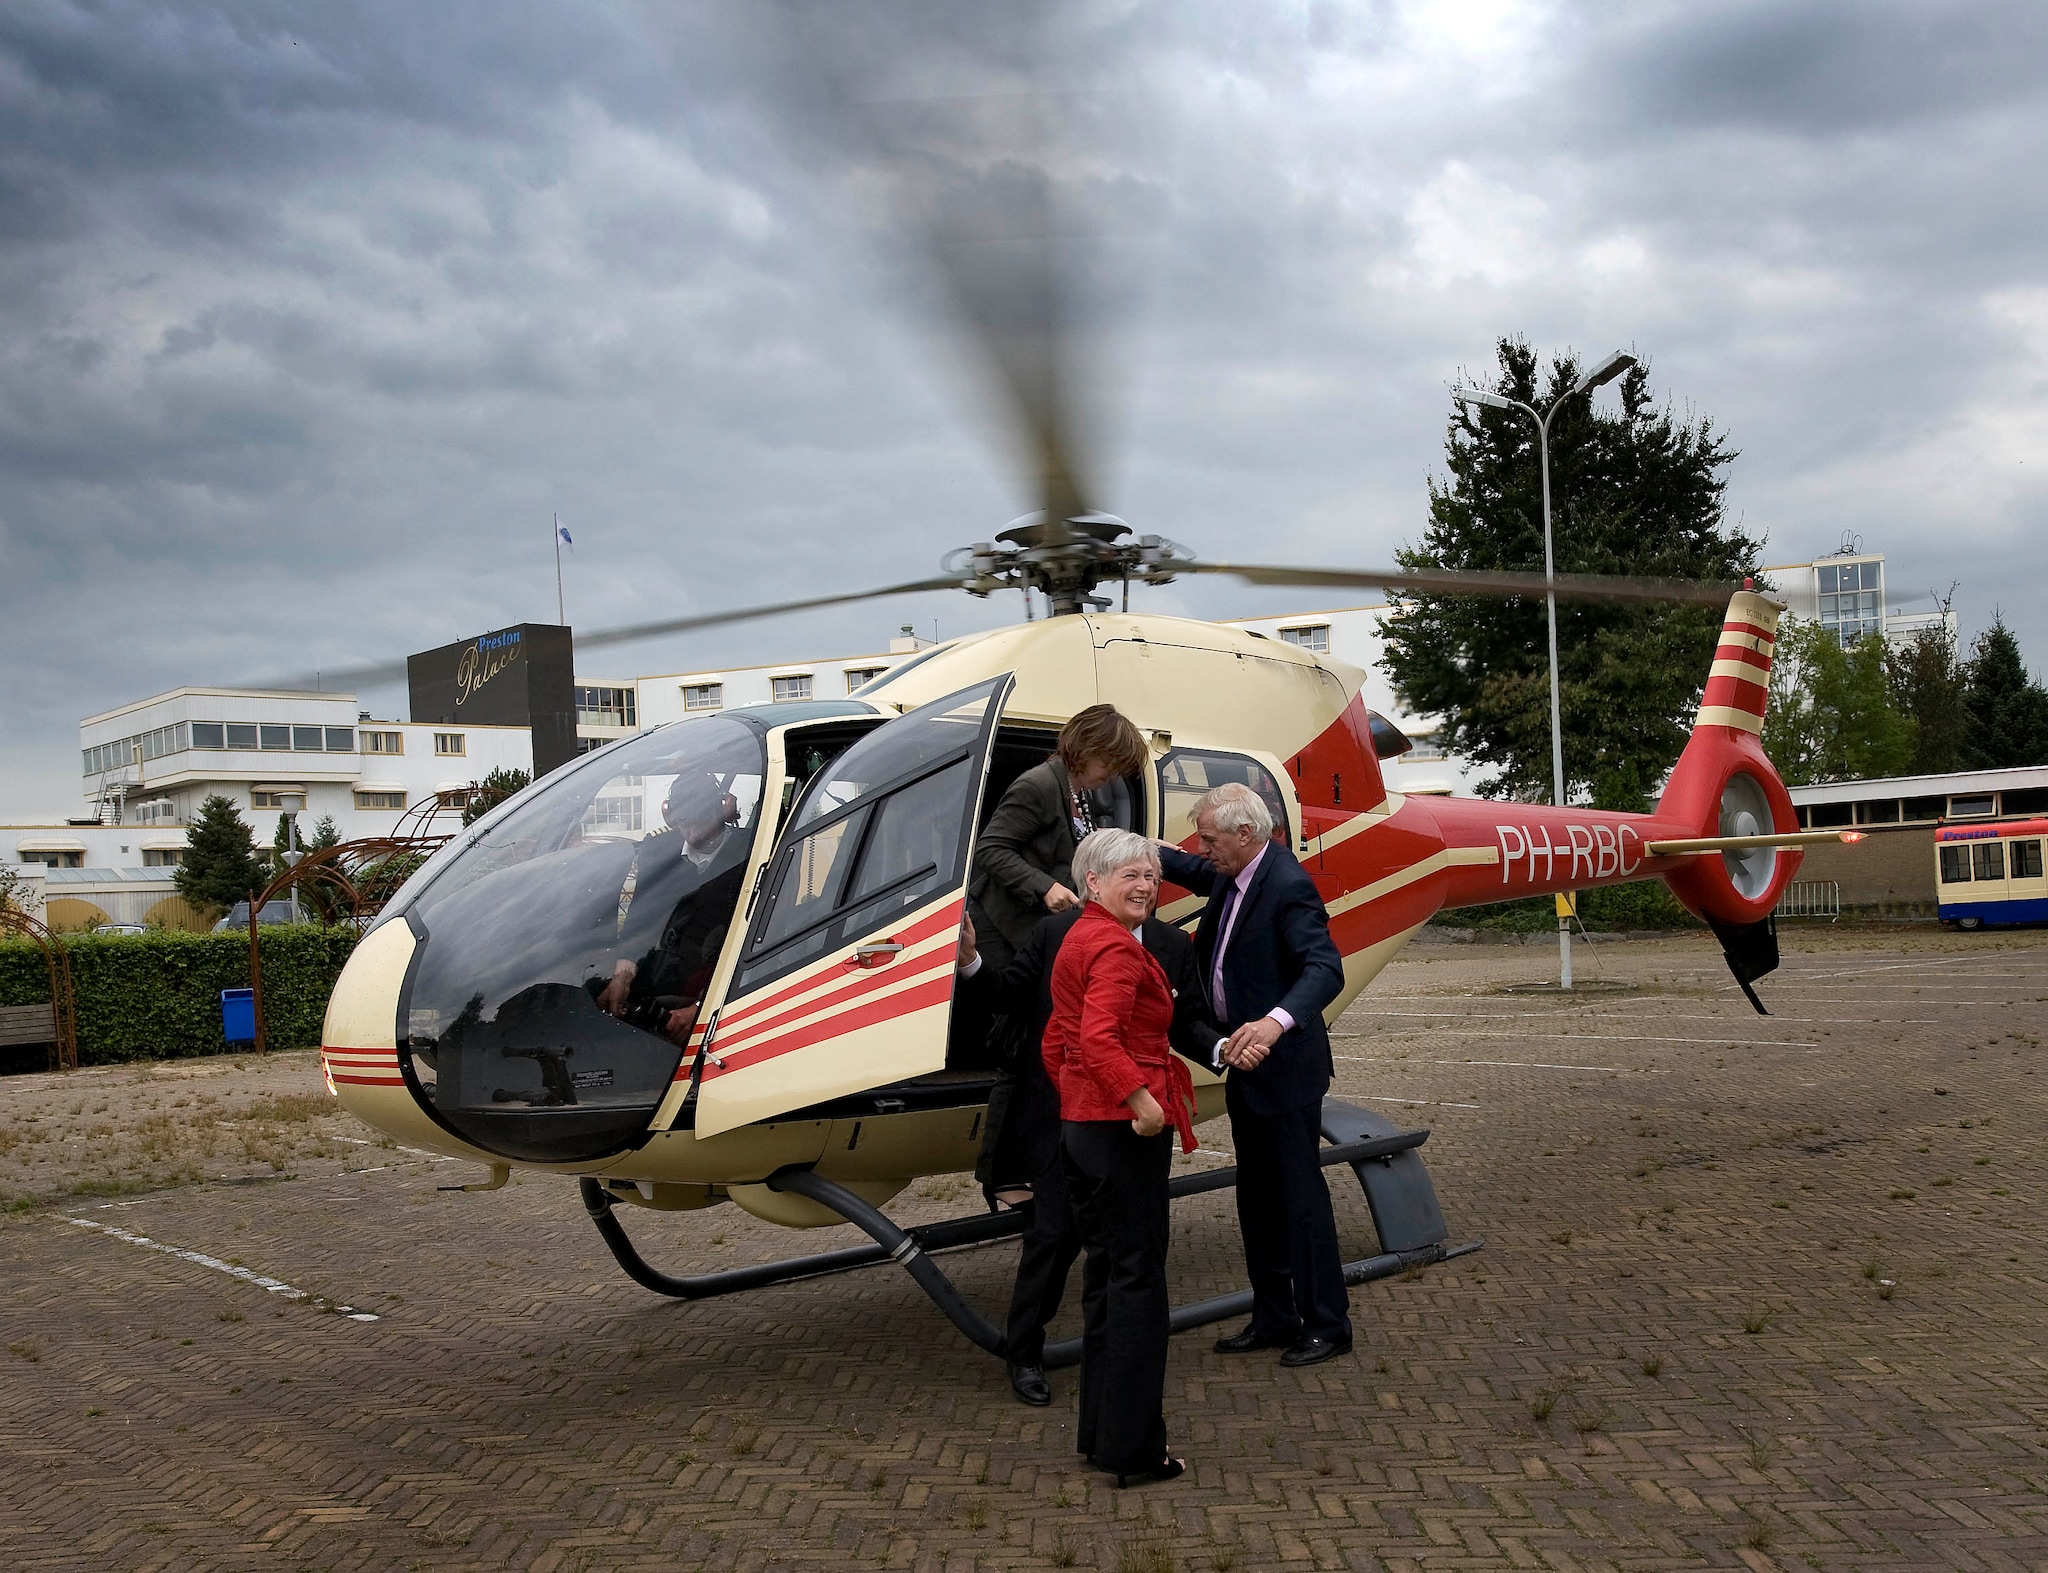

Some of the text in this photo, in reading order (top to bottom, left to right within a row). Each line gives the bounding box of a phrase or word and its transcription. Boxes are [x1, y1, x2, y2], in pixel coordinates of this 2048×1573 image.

[479, 631, 520, 653] Preston
[455, 641, 521, 705] Palace
[1495, 824, 1641, 884] PH-RBC
